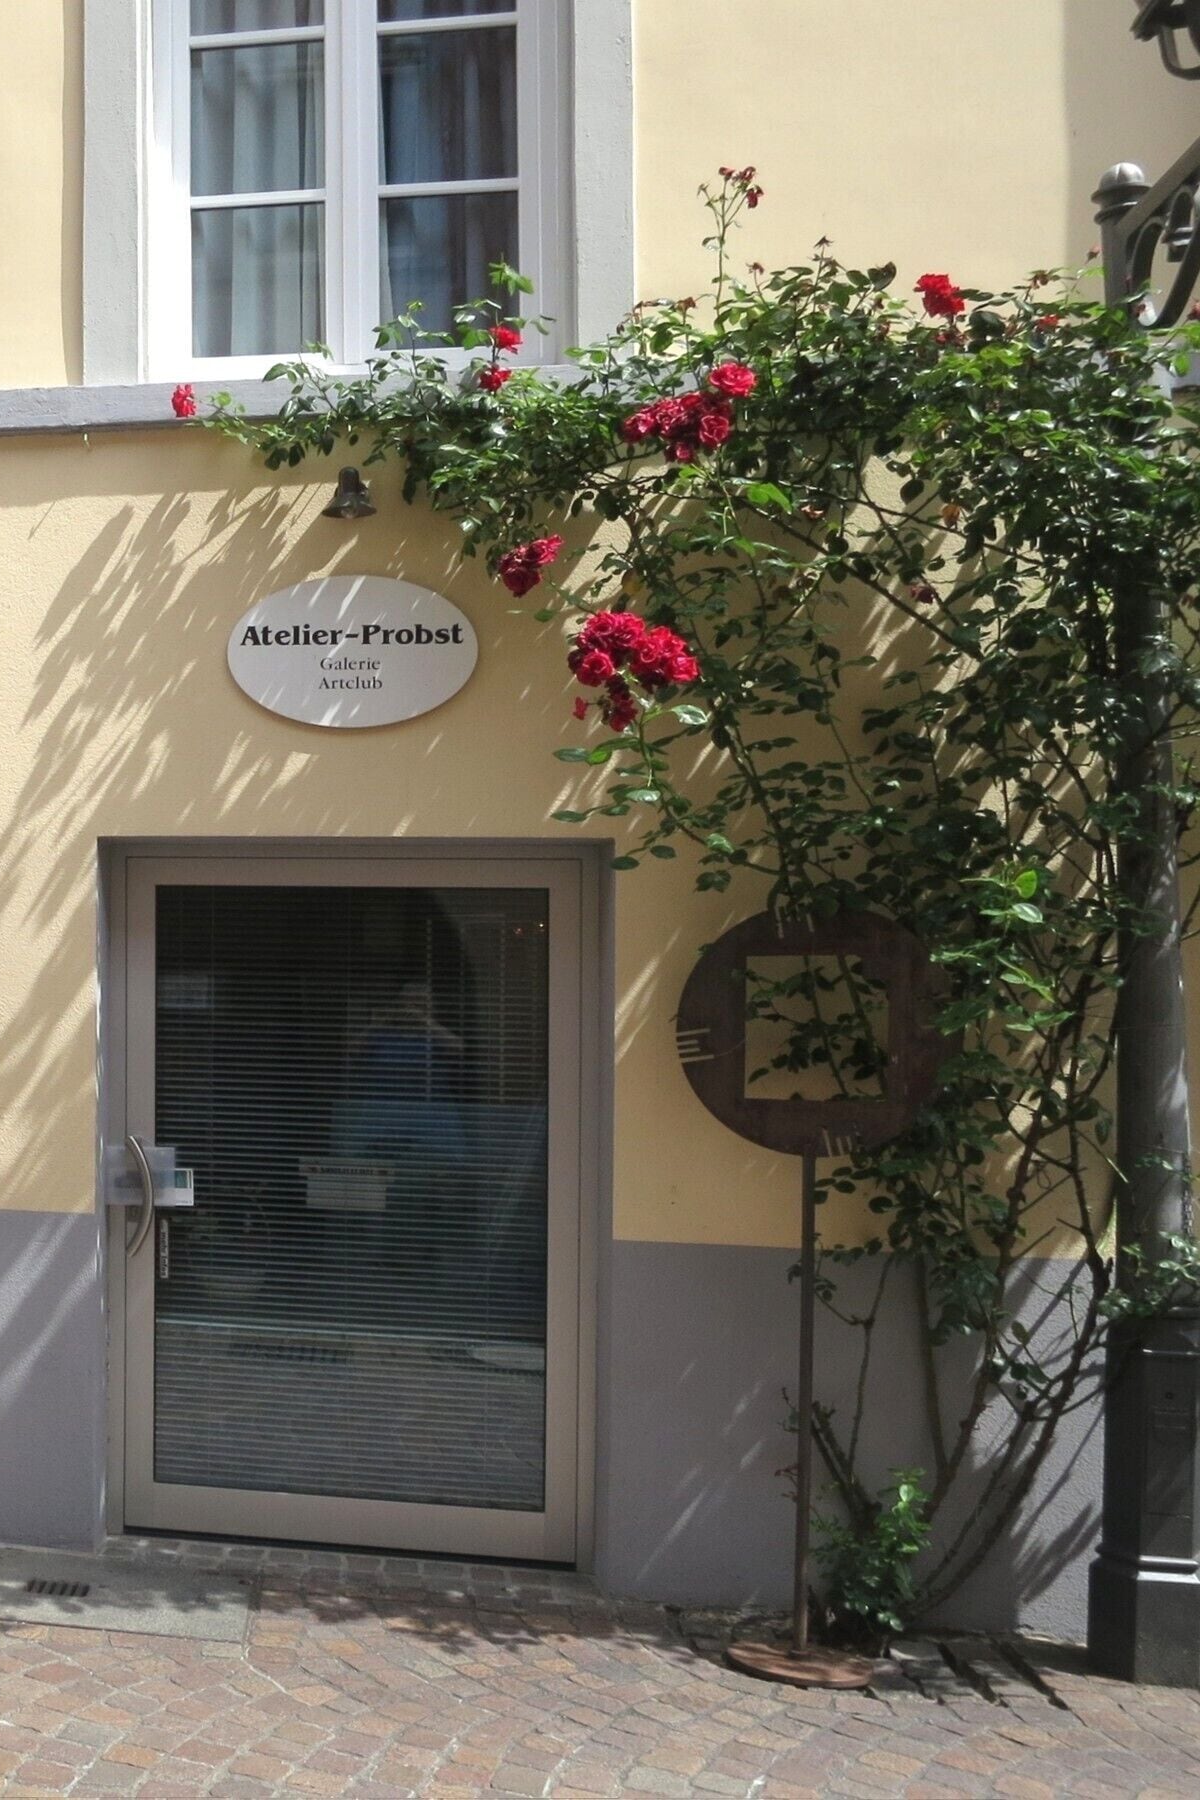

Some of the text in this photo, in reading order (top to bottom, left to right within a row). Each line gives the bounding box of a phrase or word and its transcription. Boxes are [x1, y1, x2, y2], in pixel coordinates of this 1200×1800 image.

[240, 623, 464, 646] Atelier-Probst
[319, 656, 381, 671] Galerie
[318, 675, 383, 690] Artclub
